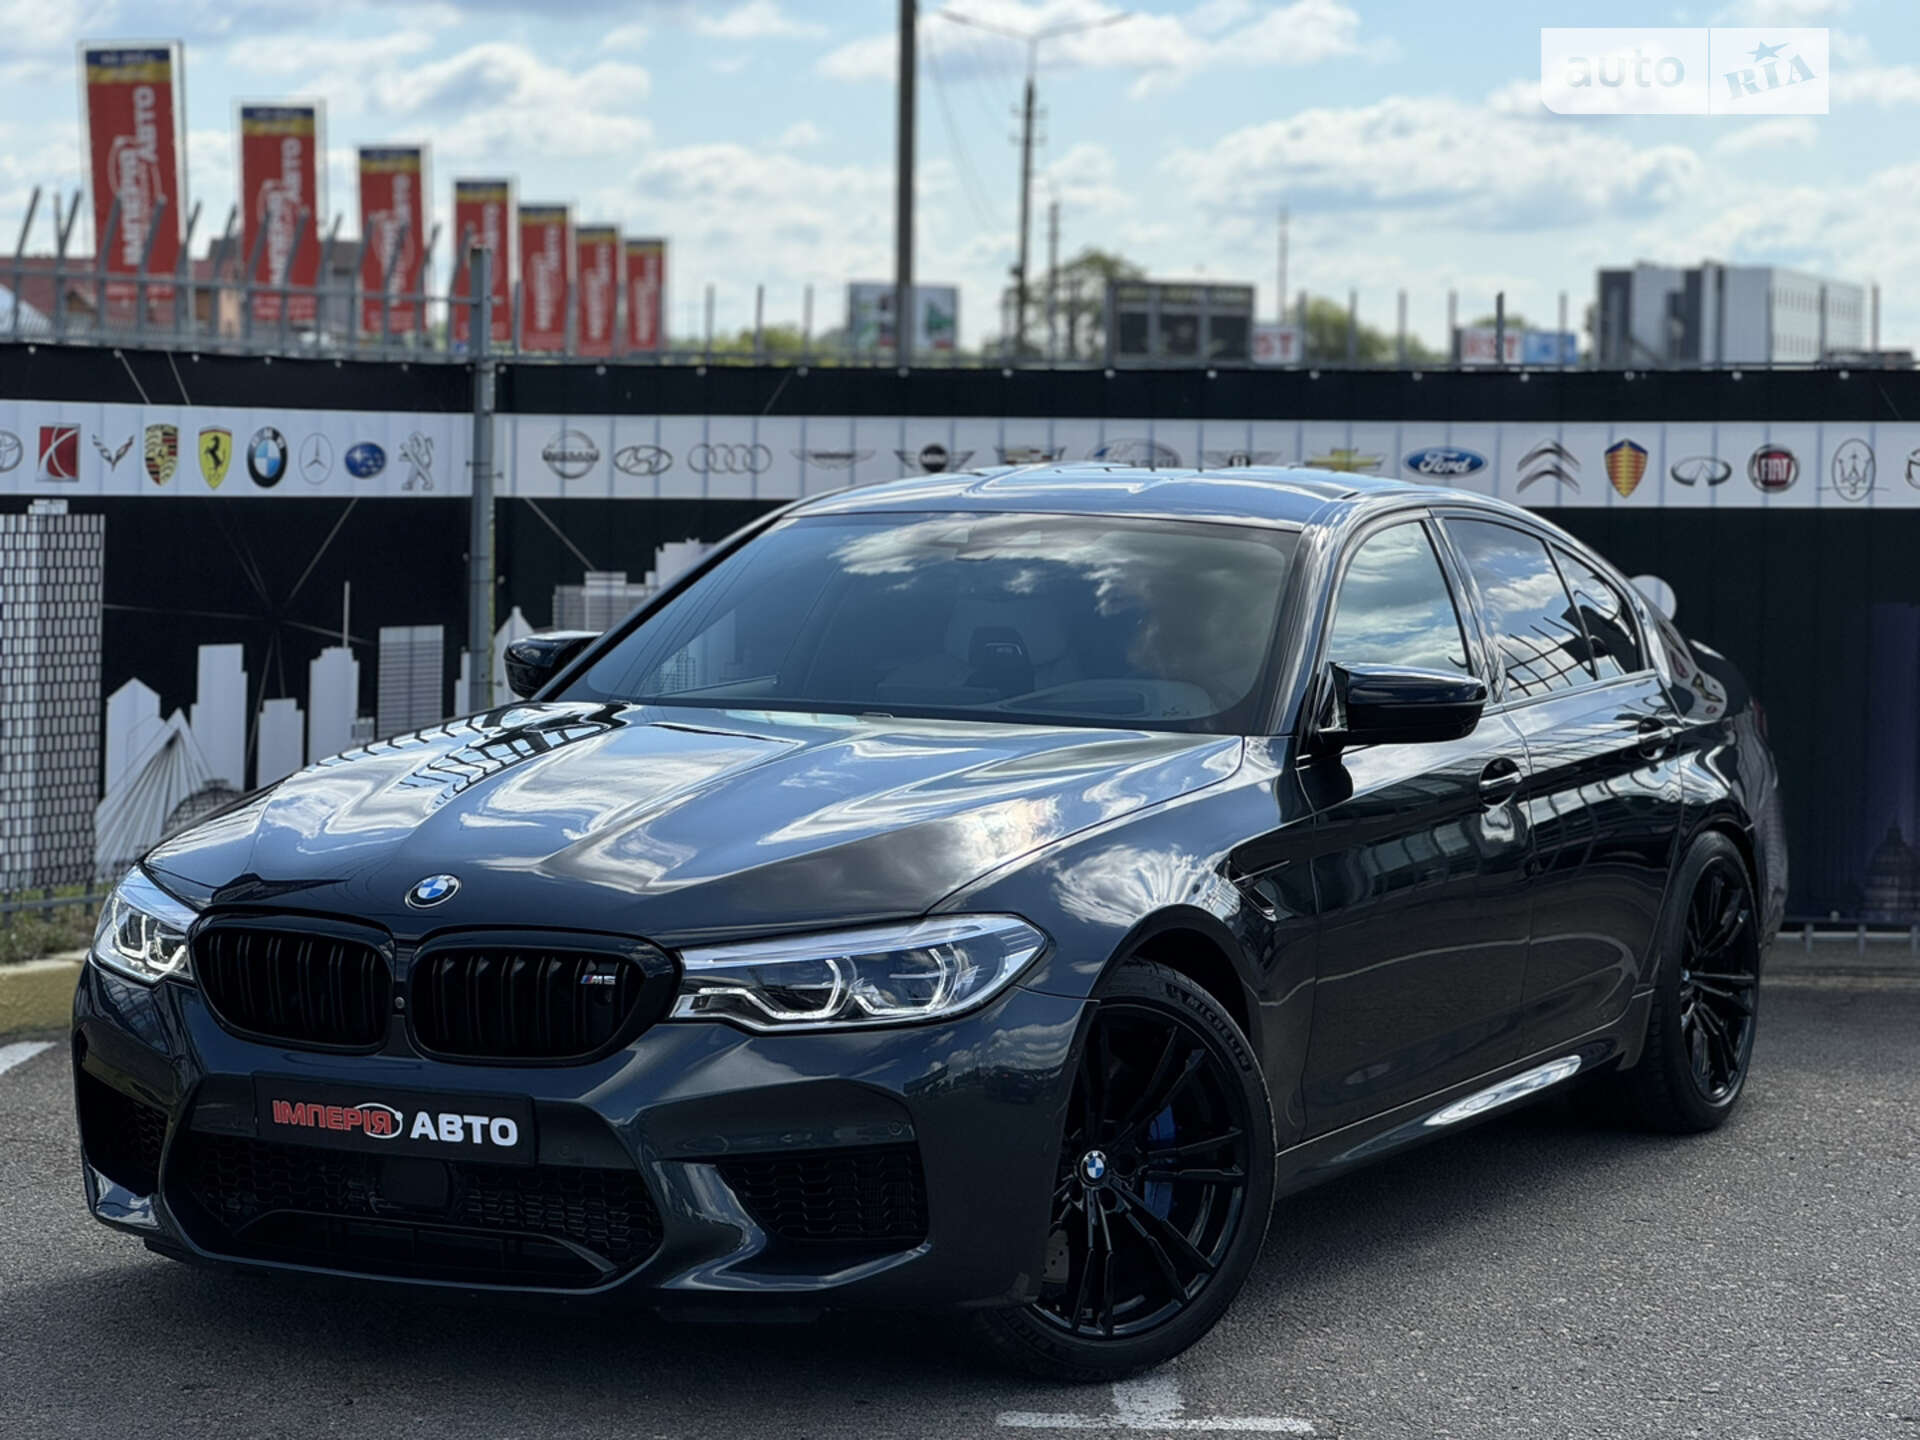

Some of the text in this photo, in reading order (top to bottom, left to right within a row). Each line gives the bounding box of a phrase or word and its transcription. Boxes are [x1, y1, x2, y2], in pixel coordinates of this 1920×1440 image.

[1419, 451, 1471, 473] Ford
[272, 1100, 518, 1147] ІМПЕРІЯ АВТО
